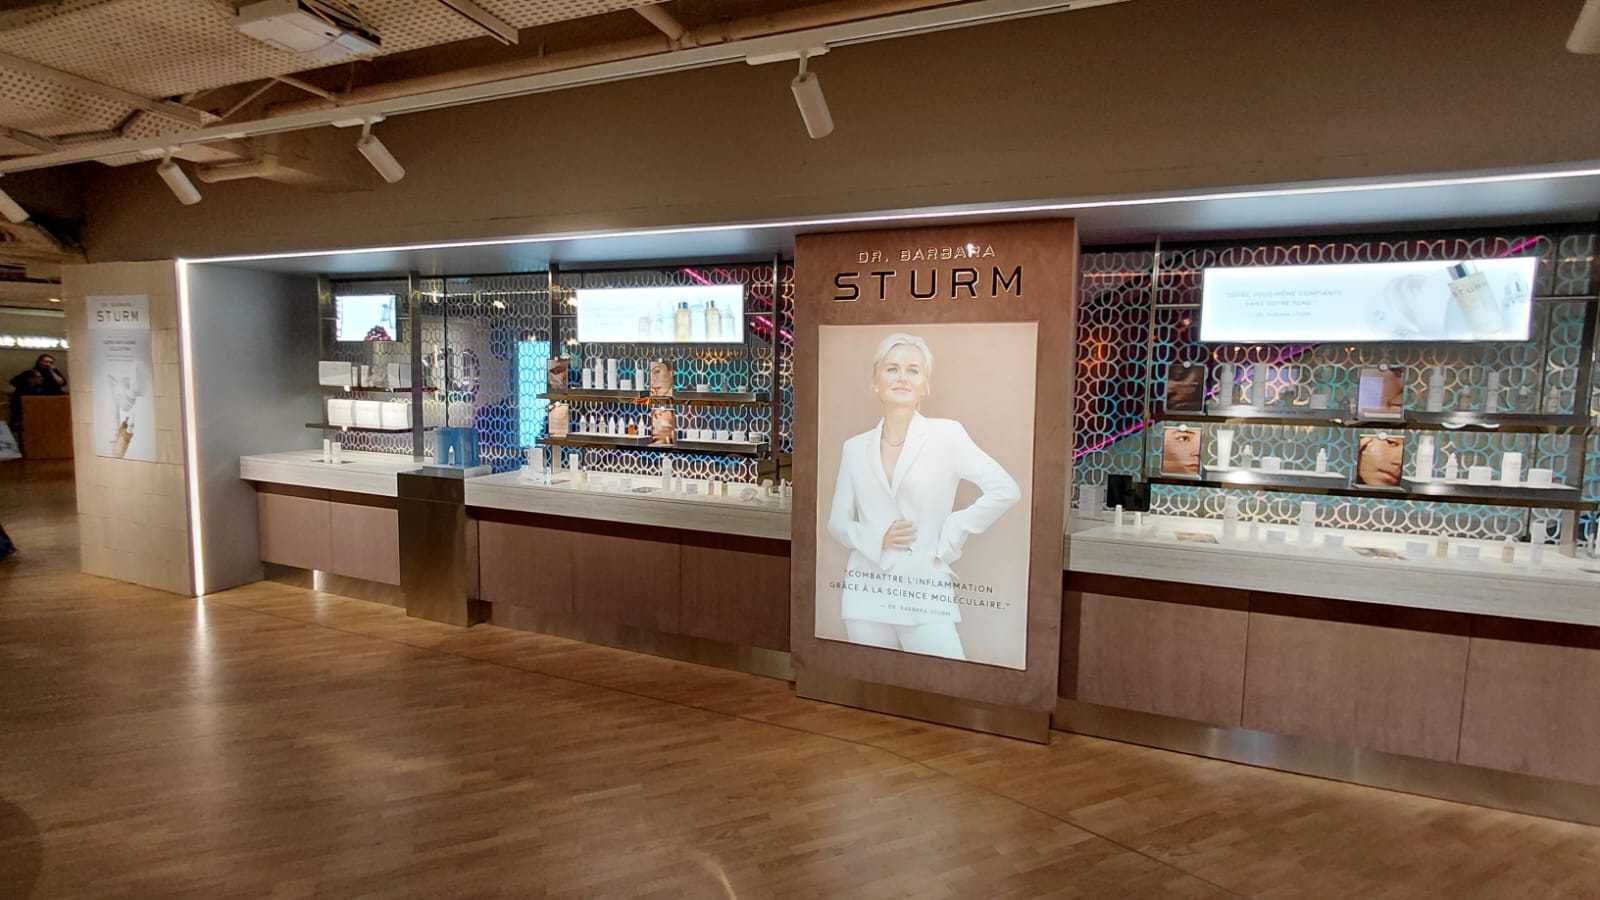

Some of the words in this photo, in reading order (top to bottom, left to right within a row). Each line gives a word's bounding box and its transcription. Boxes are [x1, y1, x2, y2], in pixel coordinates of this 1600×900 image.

[857, 250, 889, 264] DR.
[900, 244, 996, 262] BARBARA
[833, 265, 1022, 302] STURM
[96, 310, 139, 322] STURM
[829, 580, 859, 591] GRÂCE
[862, 582, 869, 592] À
[872, 586, 882, 594] LA
[886, 588, 927, 600] SCIENCE
[907, 576, 993, 594] L'INFLAMMATION
